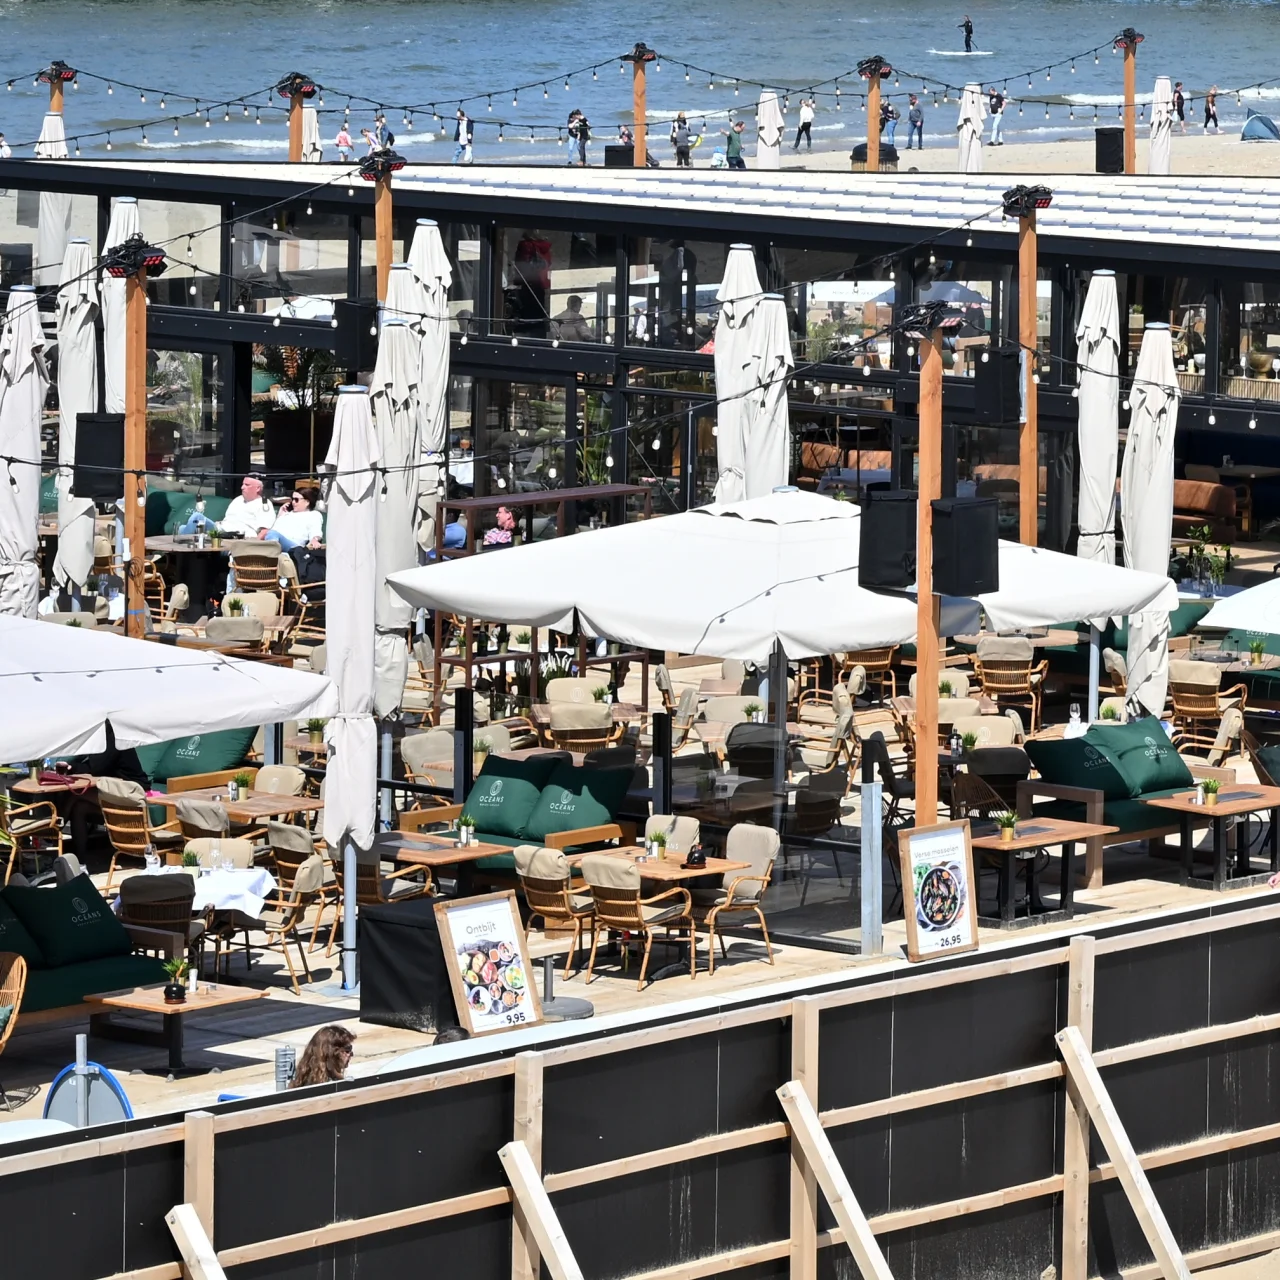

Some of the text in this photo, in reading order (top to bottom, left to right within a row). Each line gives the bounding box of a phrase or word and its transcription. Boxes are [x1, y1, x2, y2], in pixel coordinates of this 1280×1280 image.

[176, 748, 200, 757] OCEANS
[479, 795, 504, 803] OCEANS
[549, 802, 575, 812] OCEANS
[914, 850, 931, 859] Verse
[932, 845, 959, 857] mosselen
[71, 910, 102, 923] OCEANS
[466, 921, 497, 934] Ontbijt
[940, 935, 961, 948] 26,95
[506, 1012, 526, 1025] 9,95
